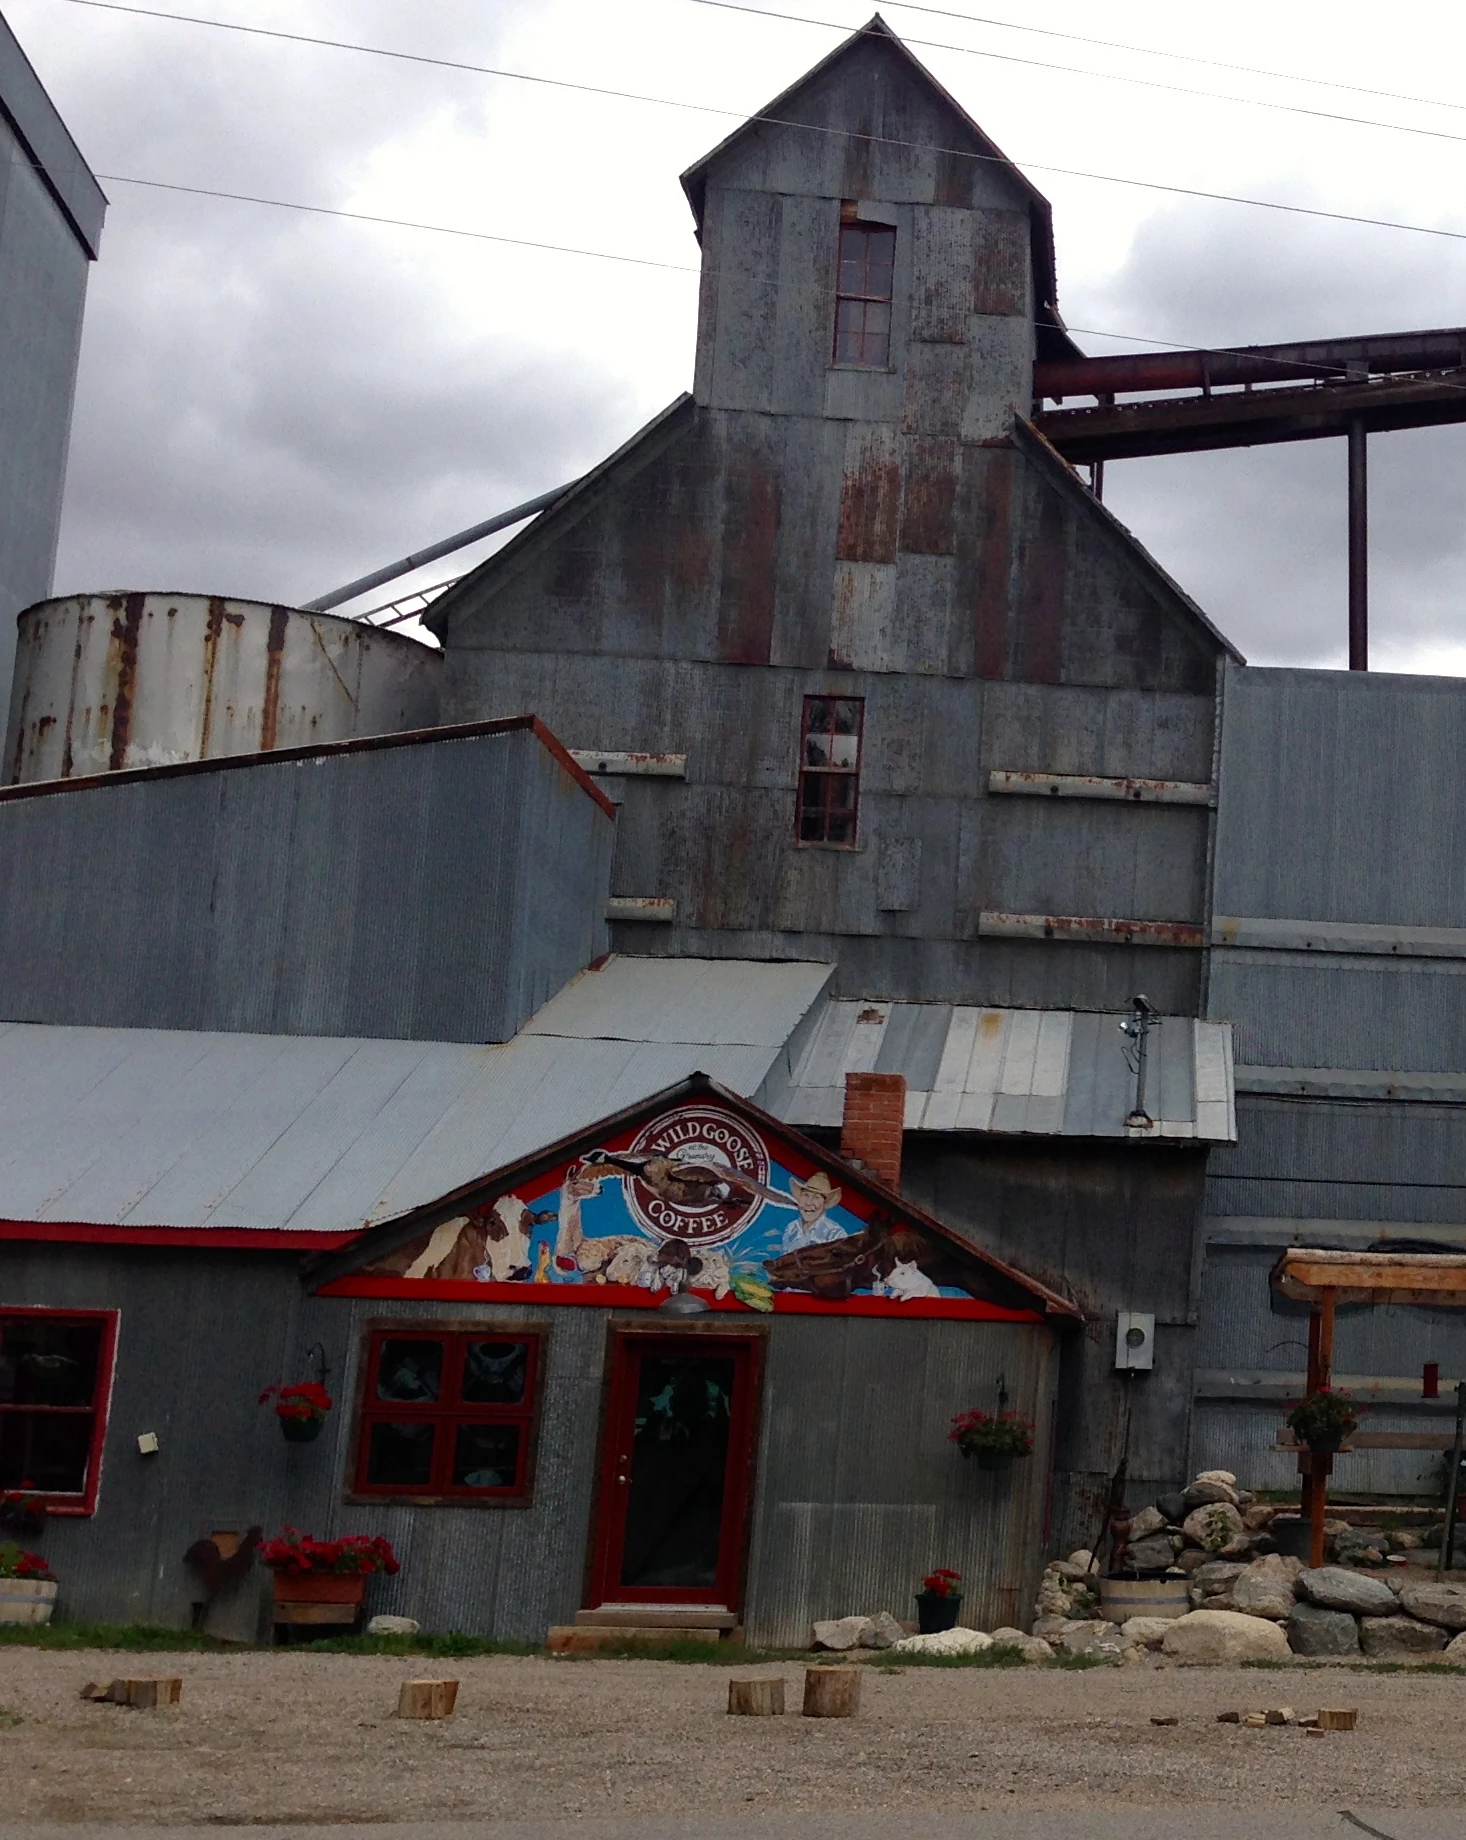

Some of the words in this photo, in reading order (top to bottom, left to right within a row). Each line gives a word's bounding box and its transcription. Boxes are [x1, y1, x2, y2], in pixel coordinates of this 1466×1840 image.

[651, 1122, 700, 1152] WILD
[702, 1123, 753, 1170] GOOSE
[648, 1200, 728, 1234] COFFEE
